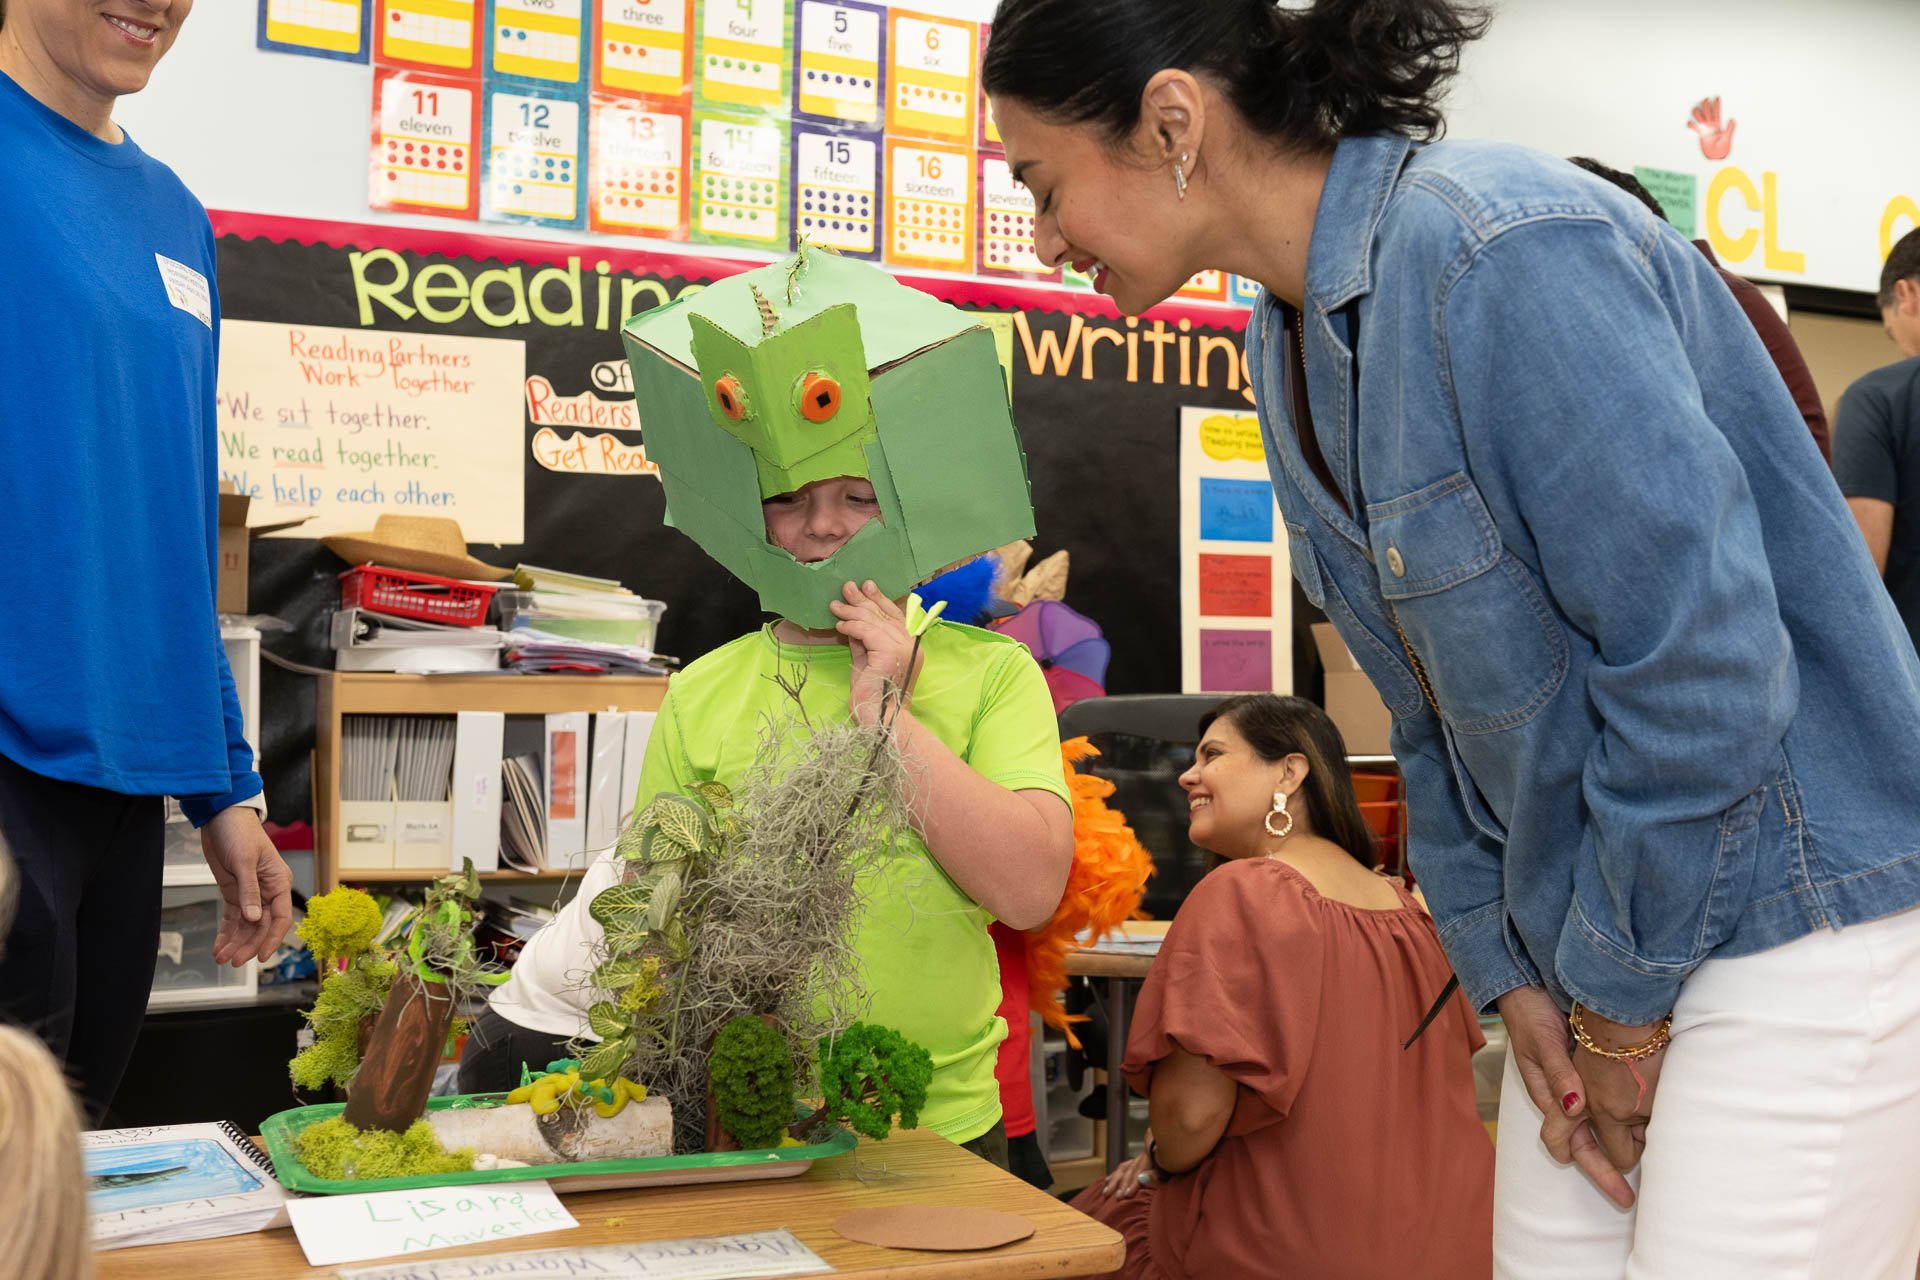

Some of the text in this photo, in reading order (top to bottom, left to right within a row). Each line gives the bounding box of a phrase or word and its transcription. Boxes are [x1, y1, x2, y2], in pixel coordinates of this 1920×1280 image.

[623, 8, 664, 25] three
[728, 20, 759, 38] four
[834, 10, 848, 33] 5
[827, 36, 853, 54] five
[925, 27, 940, 50] 6
[923, 54, 940, 66] six
[412, 89, 438, 116] 11
[399, 117, 453, 135] eleven
[519, 103, 550, 129] 12
[627, 116, 655, 141] 13
[825, 140, 850, 165] 15
[814, 165, 860, 184] fifteen
[916, 155, 942, 180] 16
[906, 181, 954, 198] sixteen
[289, 329, 471, 378] Reading Partners
[299, 360, 475, 397] Work Together
[226, 391, 430, 434] We sit together.
[526, 378, 632, 427] Readers
[221, 431, 439, 473] We read together.
[534, 429, 588, 471] Get
[223, 470, 456, 507] We help each other.
